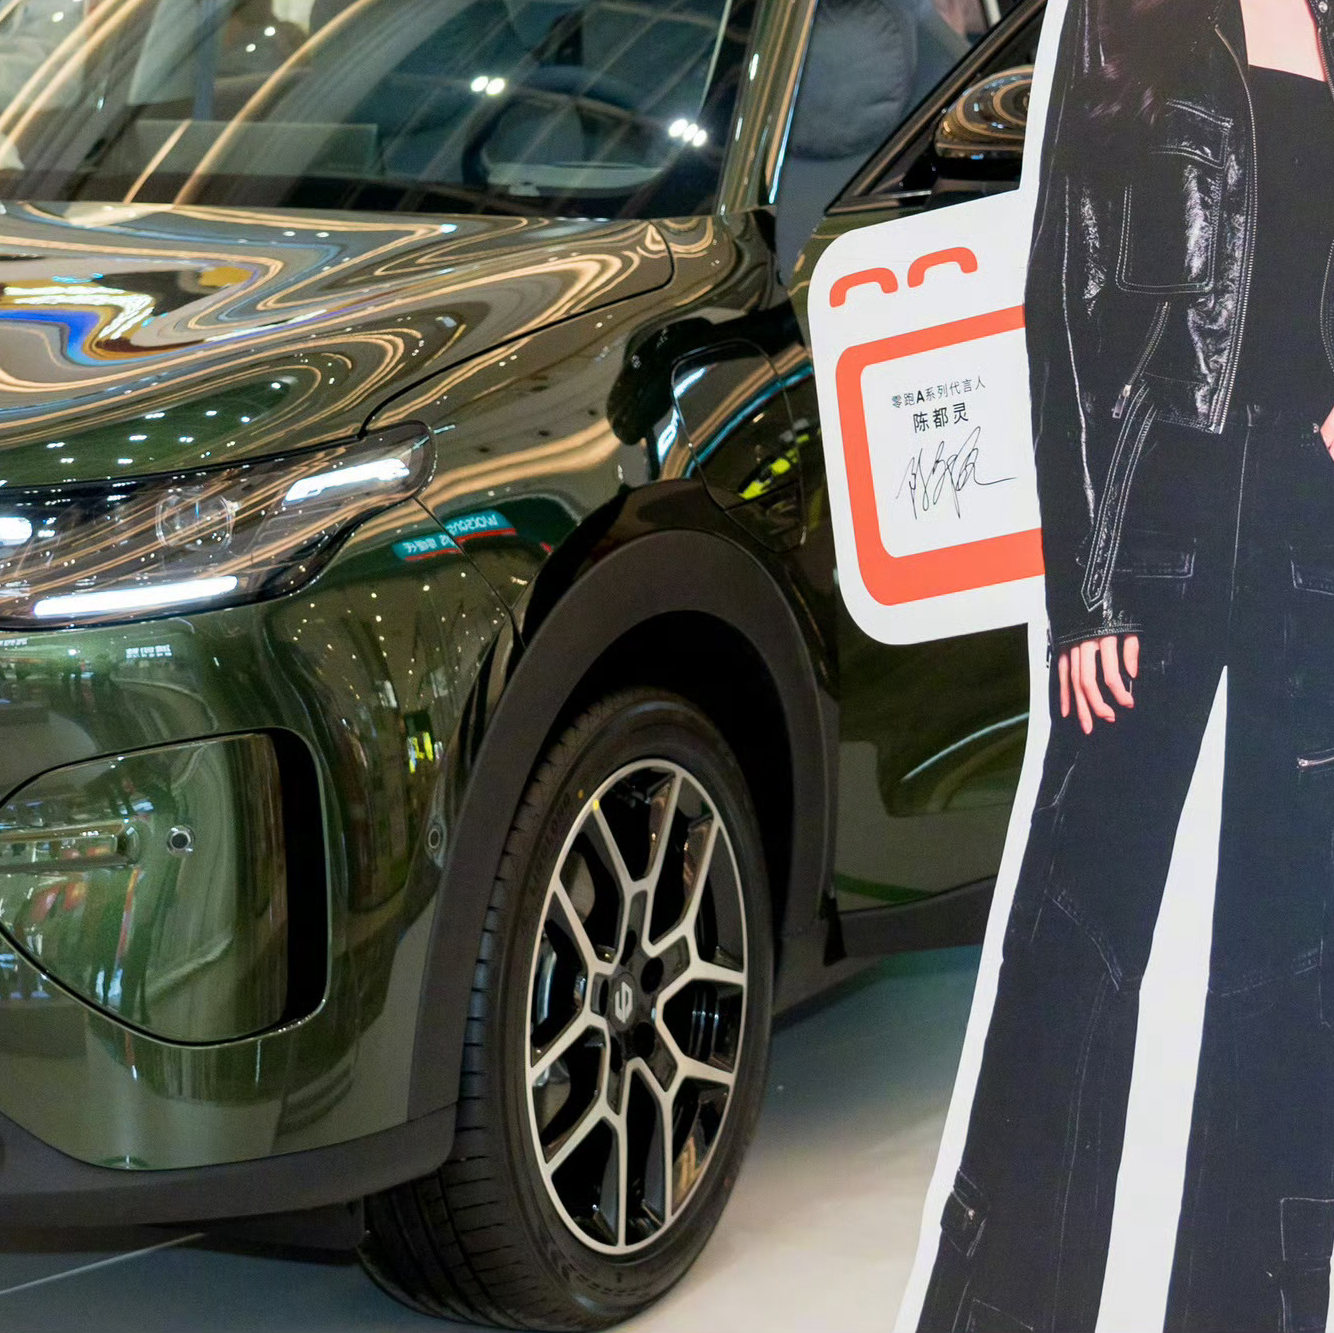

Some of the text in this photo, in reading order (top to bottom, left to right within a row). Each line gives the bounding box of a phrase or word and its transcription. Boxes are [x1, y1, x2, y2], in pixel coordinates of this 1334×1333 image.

[891, 375, 986, 409] 零跑A系列代言人
[912, 402, 970, 434] 陈都灵
